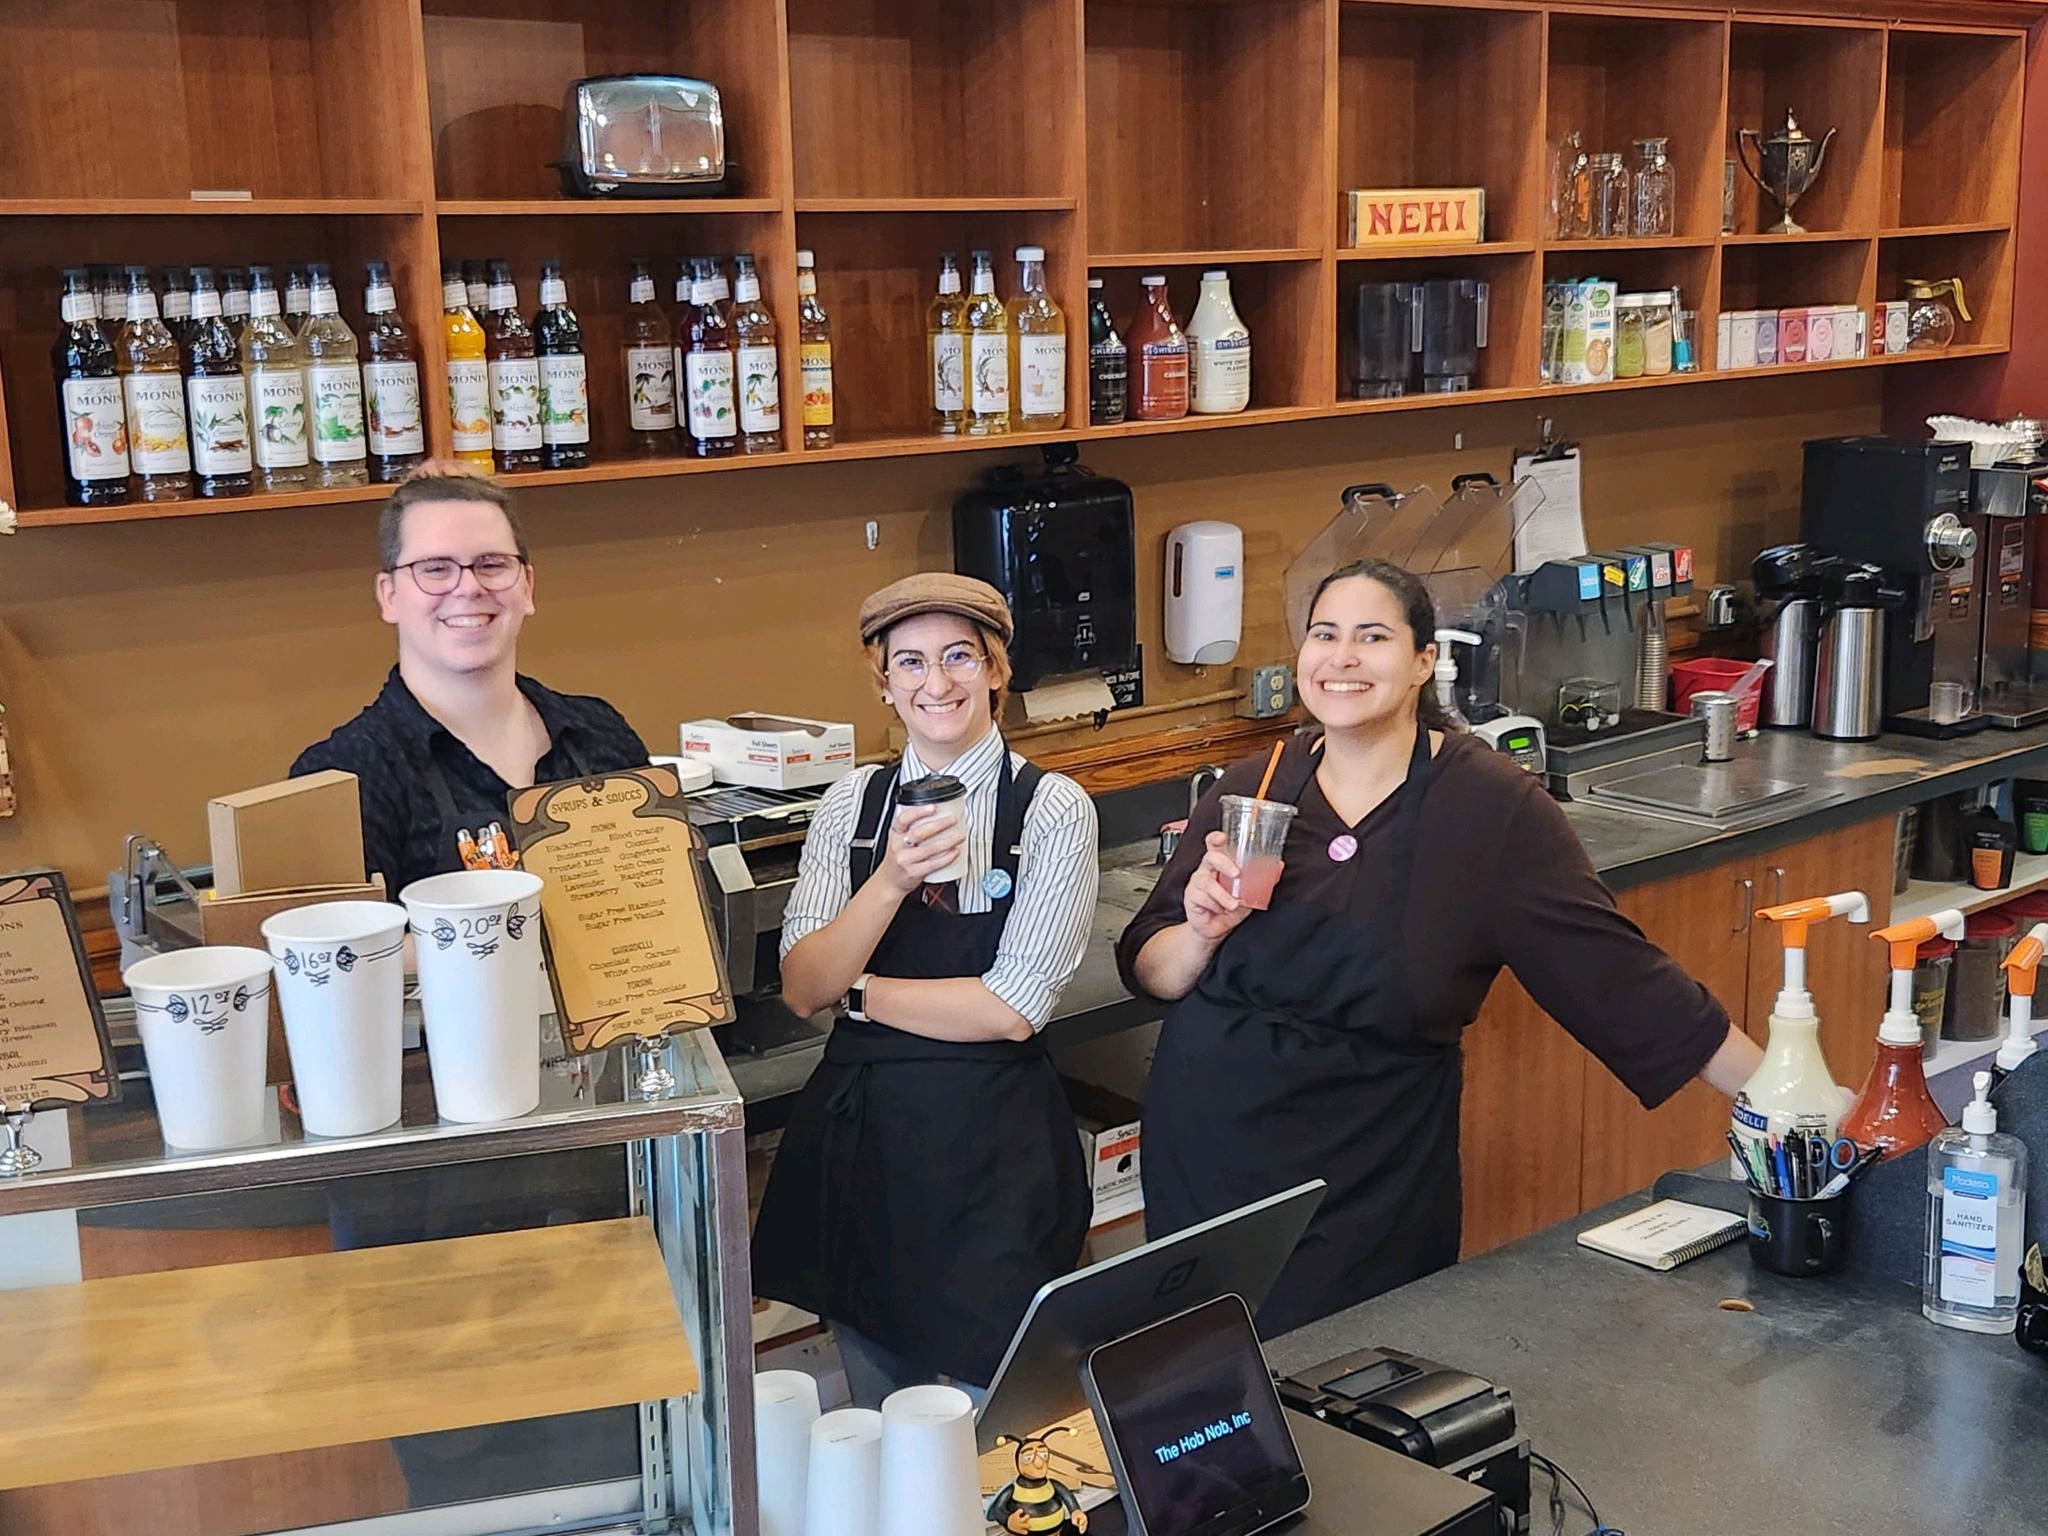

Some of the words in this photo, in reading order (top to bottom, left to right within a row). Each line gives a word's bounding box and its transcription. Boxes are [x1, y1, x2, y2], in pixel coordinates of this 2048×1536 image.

[1368, 201, 1466, 235] NEHI
[1590, 309, 1611, 318] BARISTA
[551, 798, 588, 815] SYRUPS
[592, 796, 603, 808] &
[606, 789, 642, 804] SAUCES
[609, 831, 632, 841] Blood
[634, 826, 664, 837] Orange
[625, 836, 659, 848] Coconut
[619, 845, 671, 860] Gingerbread
[549, 862, 581, 873] Frosted
[583, 857, 605, 867] Mint
[637, 857, 665, 867] Cream
[560, 870, 599, 882] Hazelnut
[620, 868, 664, 881] Raspberry
[565, 880, 605, 892] Lavender
[634, 879, 664, 889] Vanilla
[571, 887, 619, 901] Strawberry
[578, 911, 604, 921] Sugar
[606, 907, 625, 916] Free
[628, 898, 667, 911] Hazelnut
[585, 920, 611, 931] Sugar
[613, 916, 632, 925] Free
[634, 909, 665, 920] Vanilla
[589, 958, 630, 971] Chocolate
[645, 946, 681, 959] Caramel
[4, 967, 33, 976] Spice
[603, 969, 628, 978] White
[631, 960, 671, 973] Chocolate
[597, 997, 622, 1008] Sugar
[625, 992, 645, 1001] Free
[646, 983, 687, 996] Chocolate
[9, 998, 46, 1008] Oolong
[14, 1022, 58, 1033] Blossom
[2, 1033, 33, 1043] Green
[7, 1059, 48, 1070] Autumn
[1957, 1212, 1983, 1223] HAND
[1946, 1218, 1994, 1232] SANITIZER
[1155, 1446, 1180, 1464] The
[1179, 1431, 1205, 1454] Hob
[1204, 1420, 1234, 1442] Nob,
[1231, 1412, 1251, 1429] Inc
